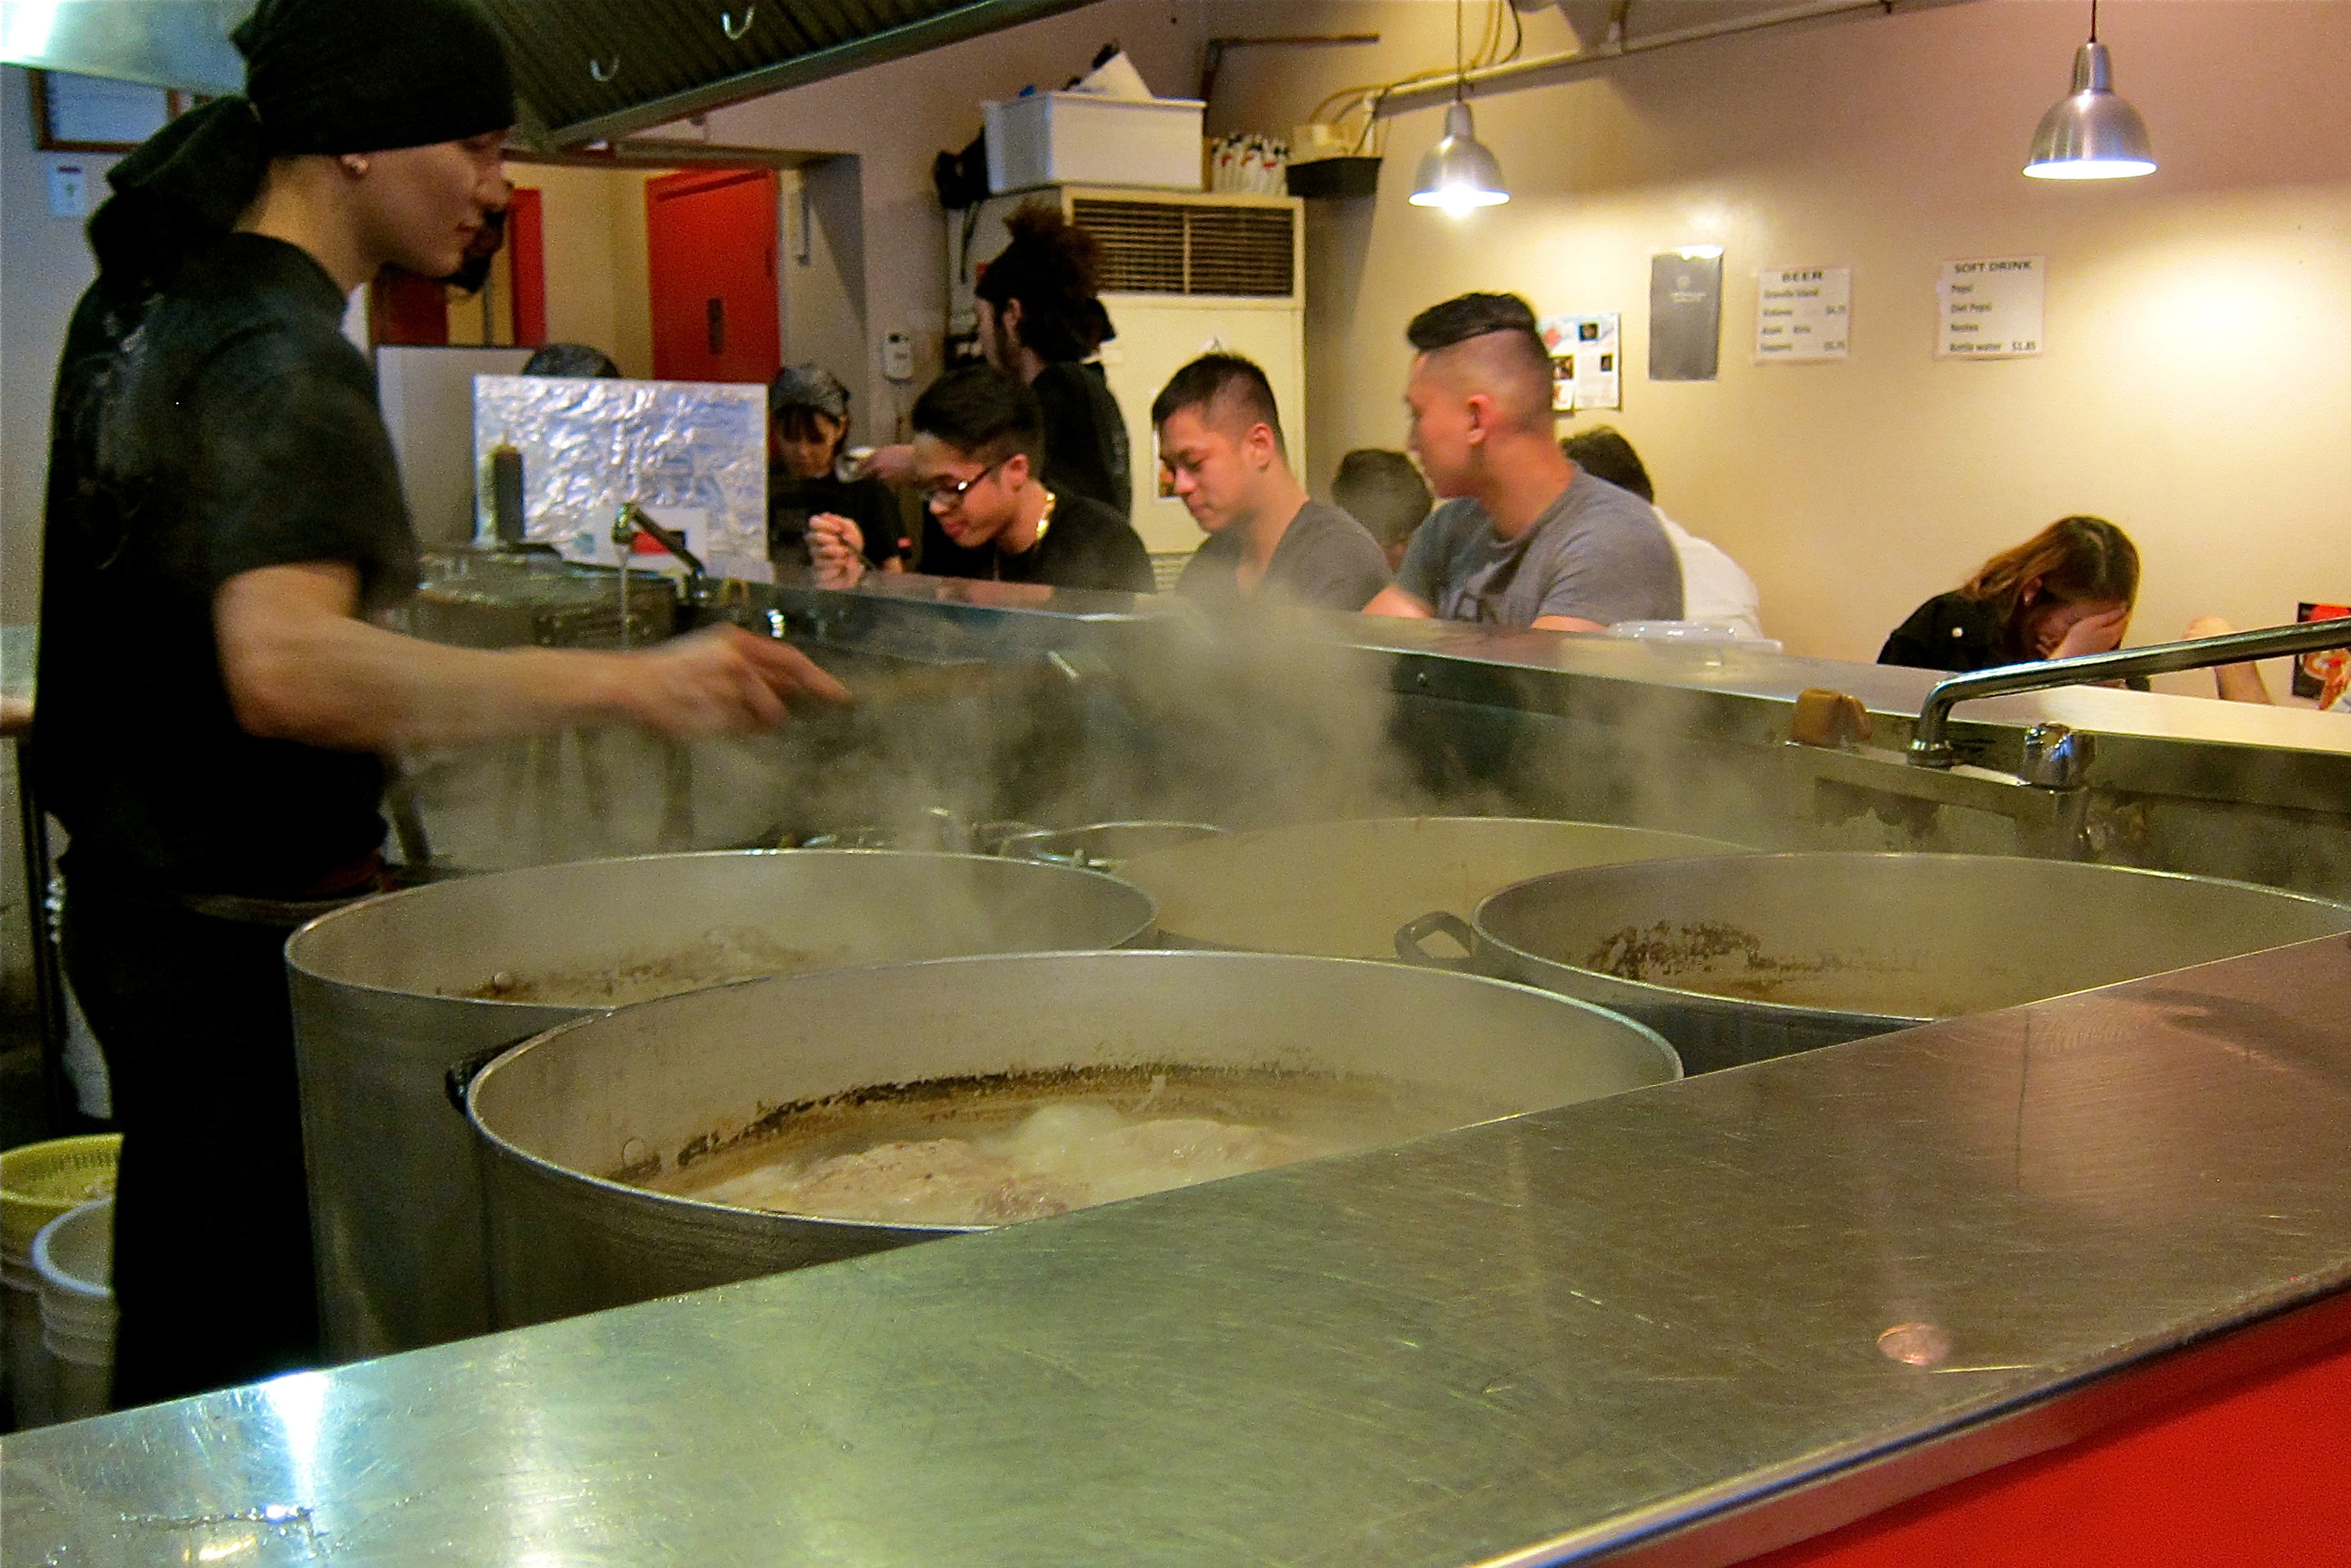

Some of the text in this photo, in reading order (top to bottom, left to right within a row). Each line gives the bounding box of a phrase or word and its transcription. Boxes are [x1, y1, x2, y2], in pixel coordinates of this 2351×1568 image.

[1955, 259, 2030, 273] SOFT DRINK
[1782, 270, 1822, 282] BEER
